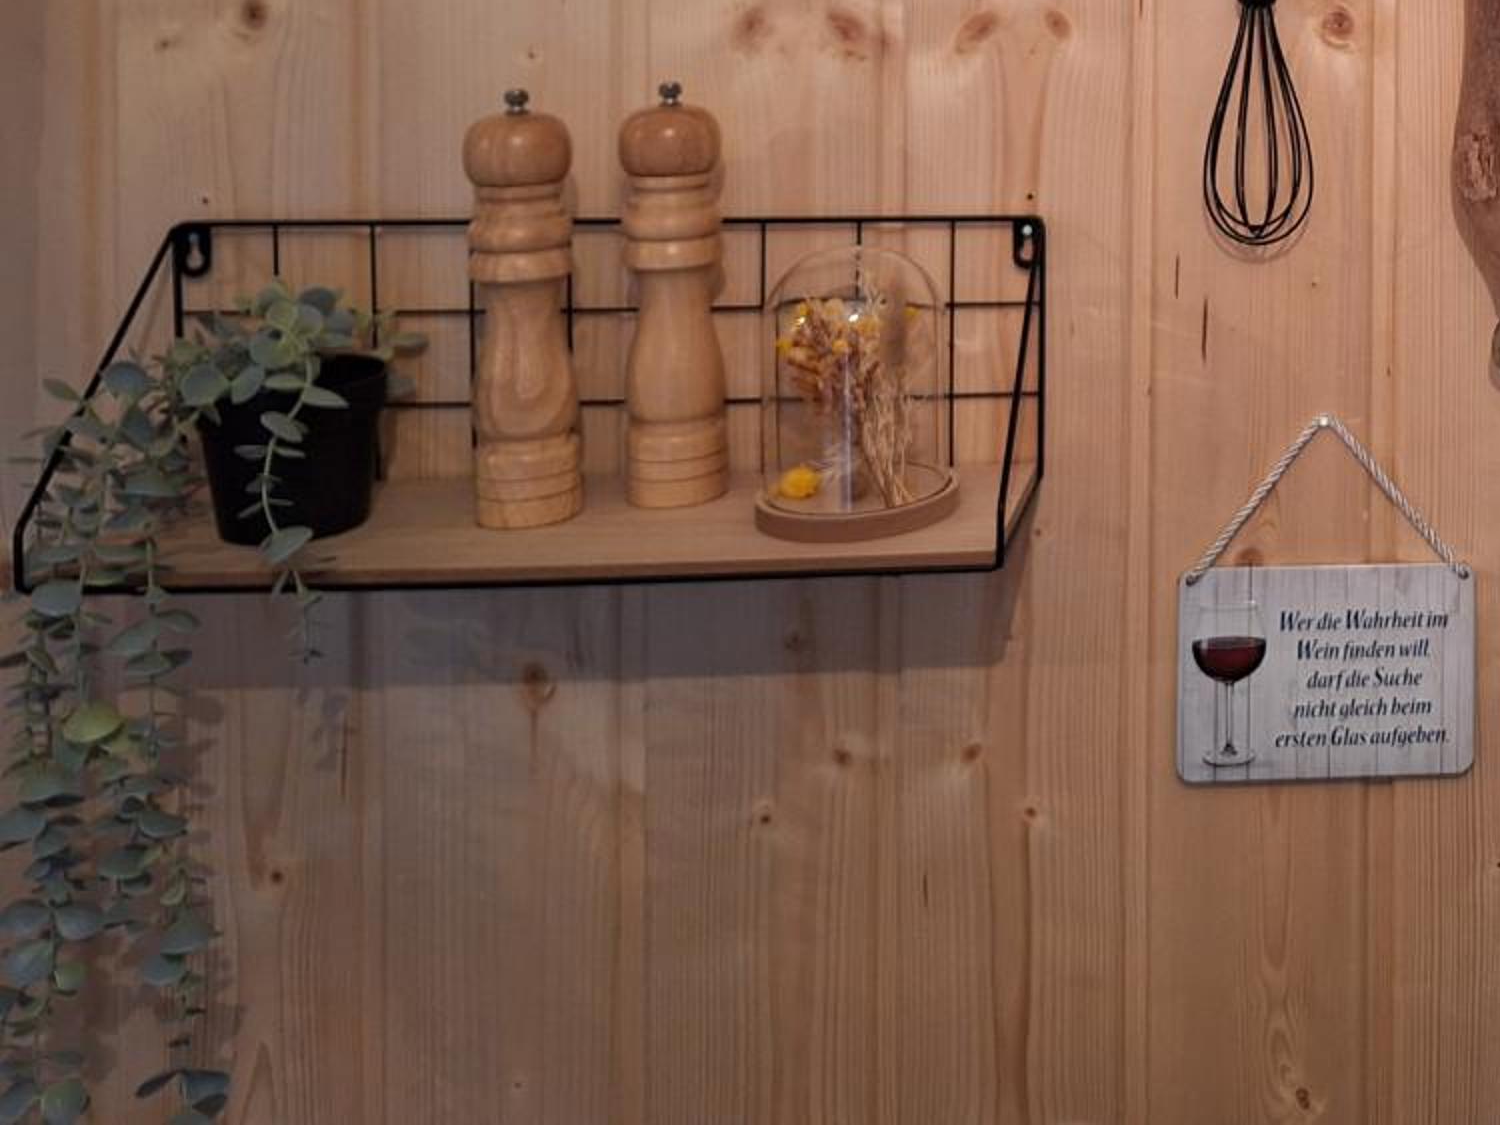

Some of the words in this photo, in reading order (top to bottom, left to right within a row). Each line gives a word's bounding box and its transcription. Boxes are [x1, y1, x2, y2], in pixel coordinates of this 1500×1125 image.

[1280, 609, 1314, 632] Wer
[1315, 610, 1342, 631] die
[1346, 607, 1425, 630] Wahrheit
[1426, 609, 1449, 629] im
[1297, 638, 1340, 661] Wein
[1341, 639, 1396, 663] finden
[1306, 669, 1346, 692] darf
[1345, 669, 1371, 688] die
[1373, 665, 1423, 688] Suche
[1293, 698, 1336, 719] nicht
[1338, 697, 1388, 721] gleich
[1391, 695, 1432, 715] beim
[1275, 730, 1327, 748] ersten
[1331, 724, 1367, 747] Glas
